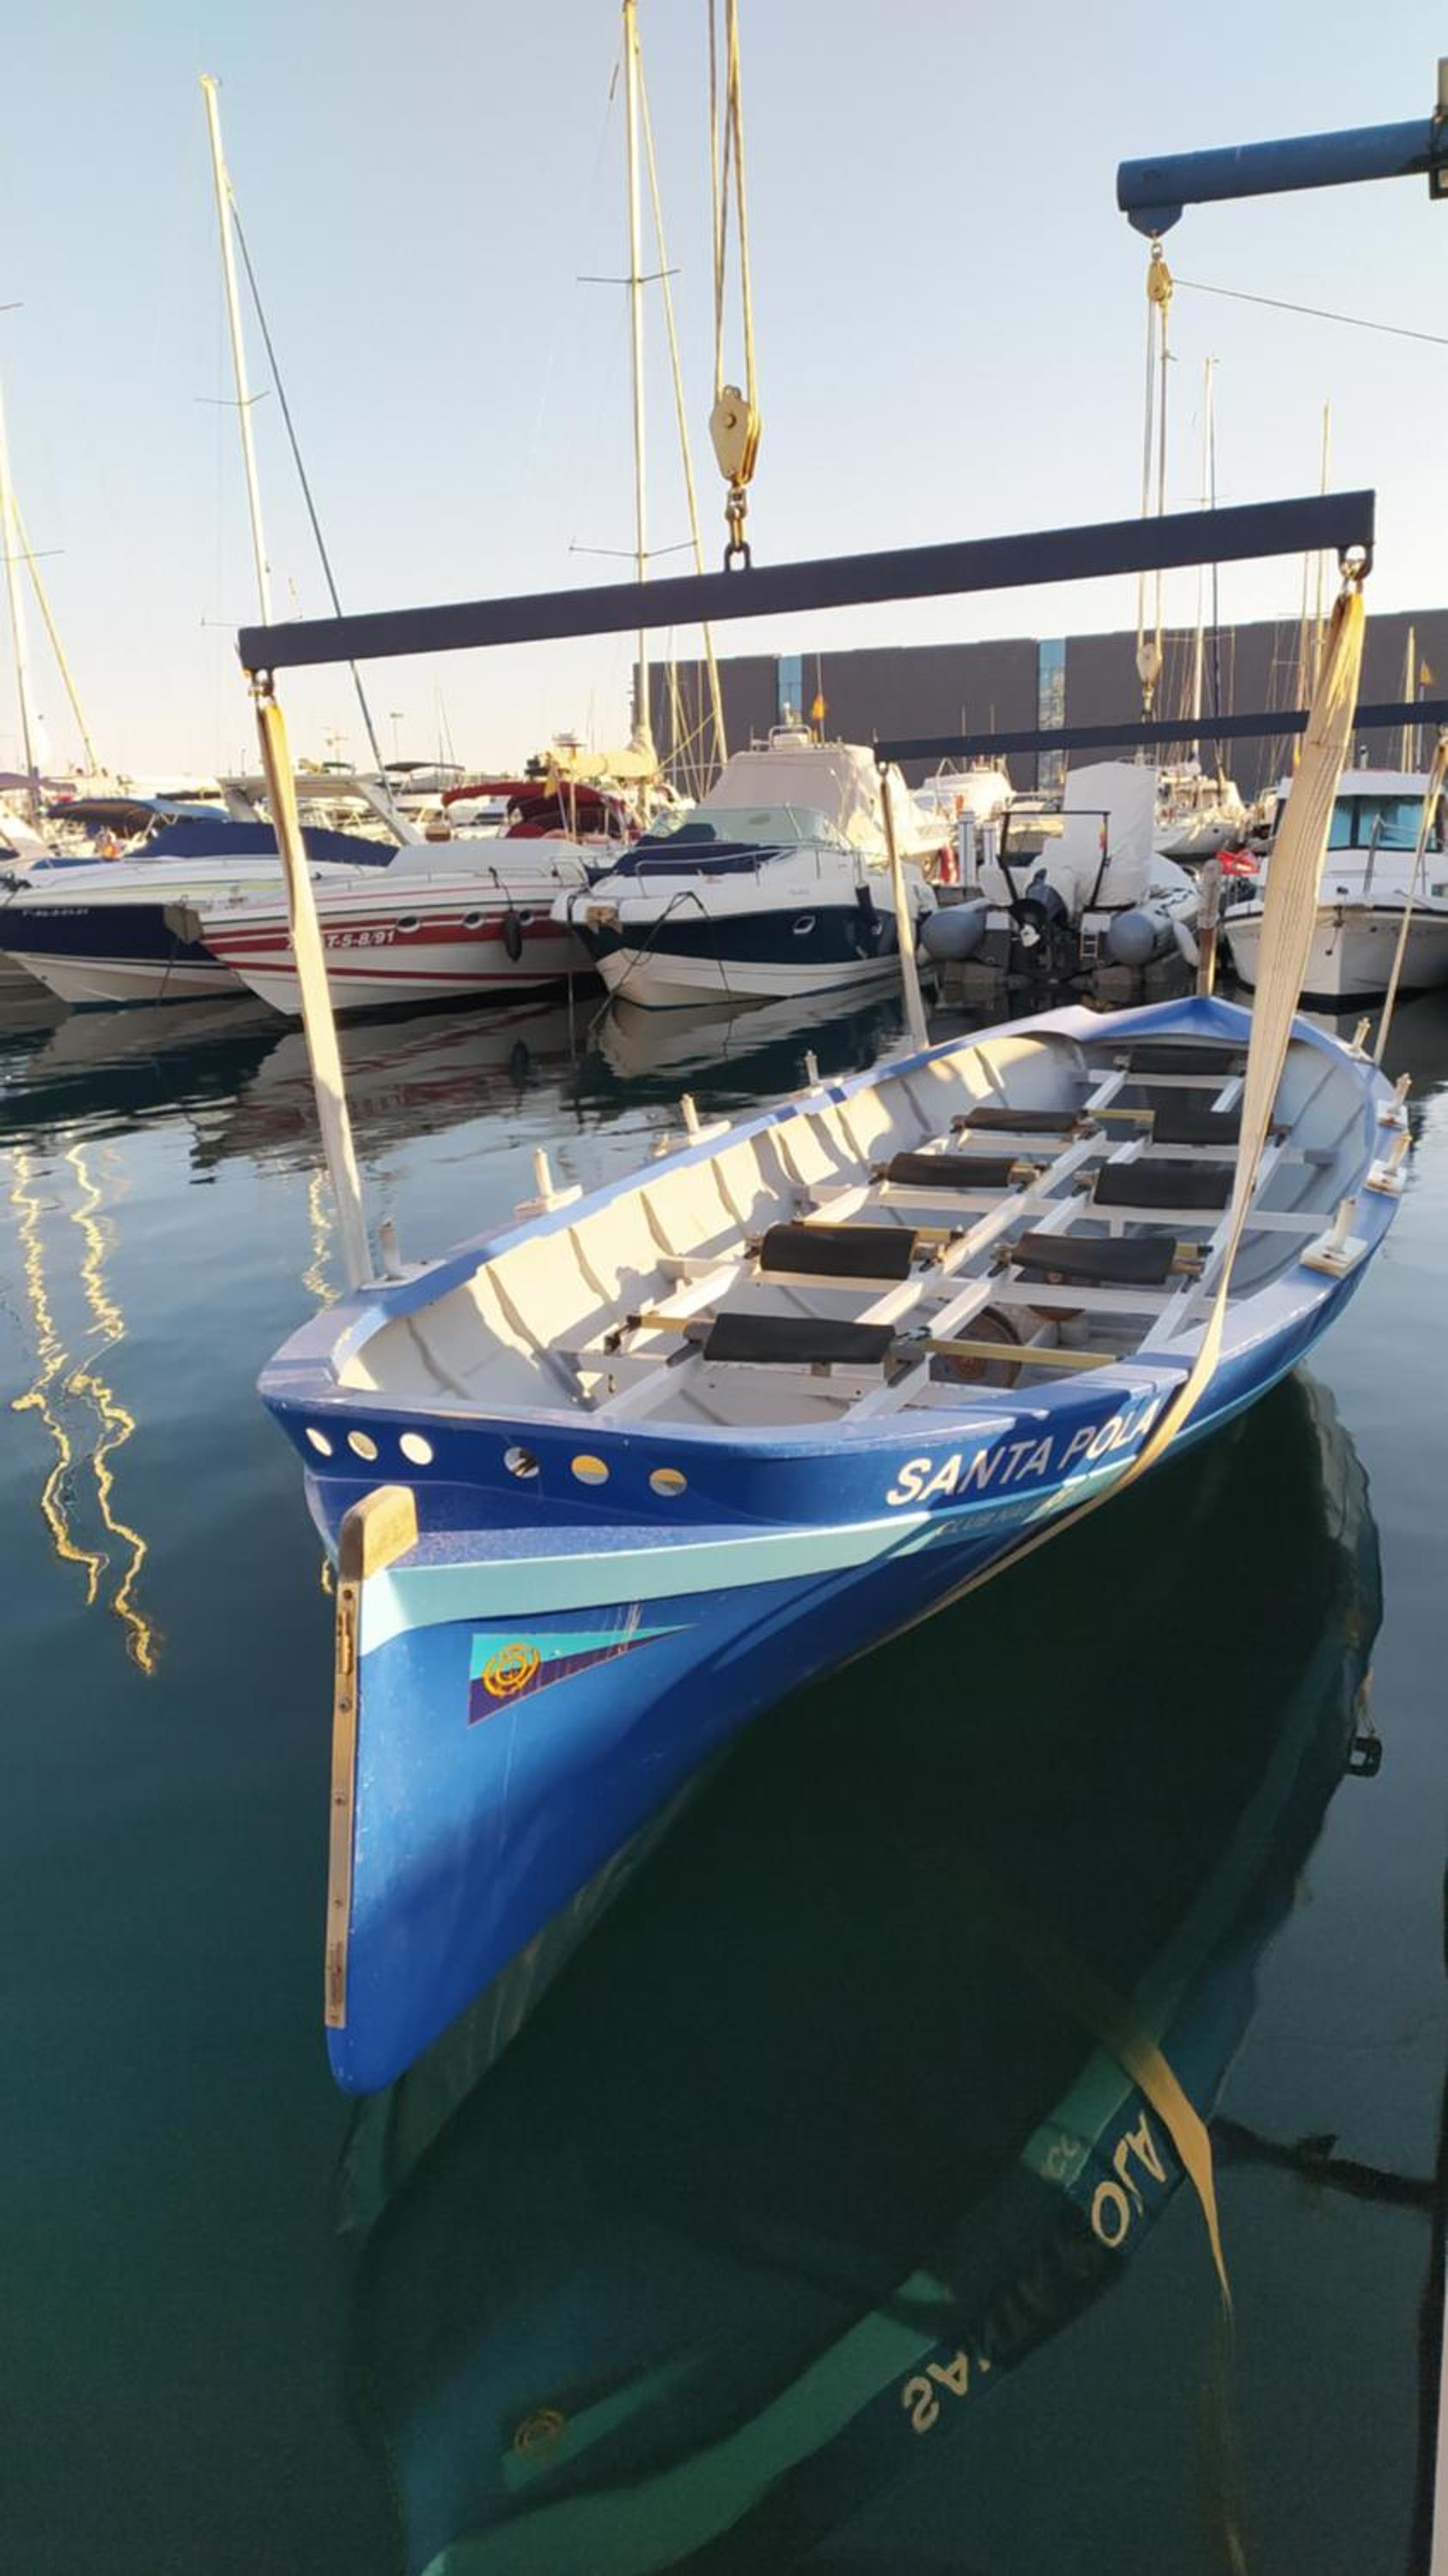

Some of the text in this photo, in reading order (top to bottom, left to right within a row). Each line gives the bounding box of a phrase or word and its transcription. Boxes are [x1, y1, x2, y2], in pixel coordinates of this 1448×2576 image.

[325, 930, 395, 948] T-5-8/91
[886, 1399, 1159, 1506] SANTA POLA
